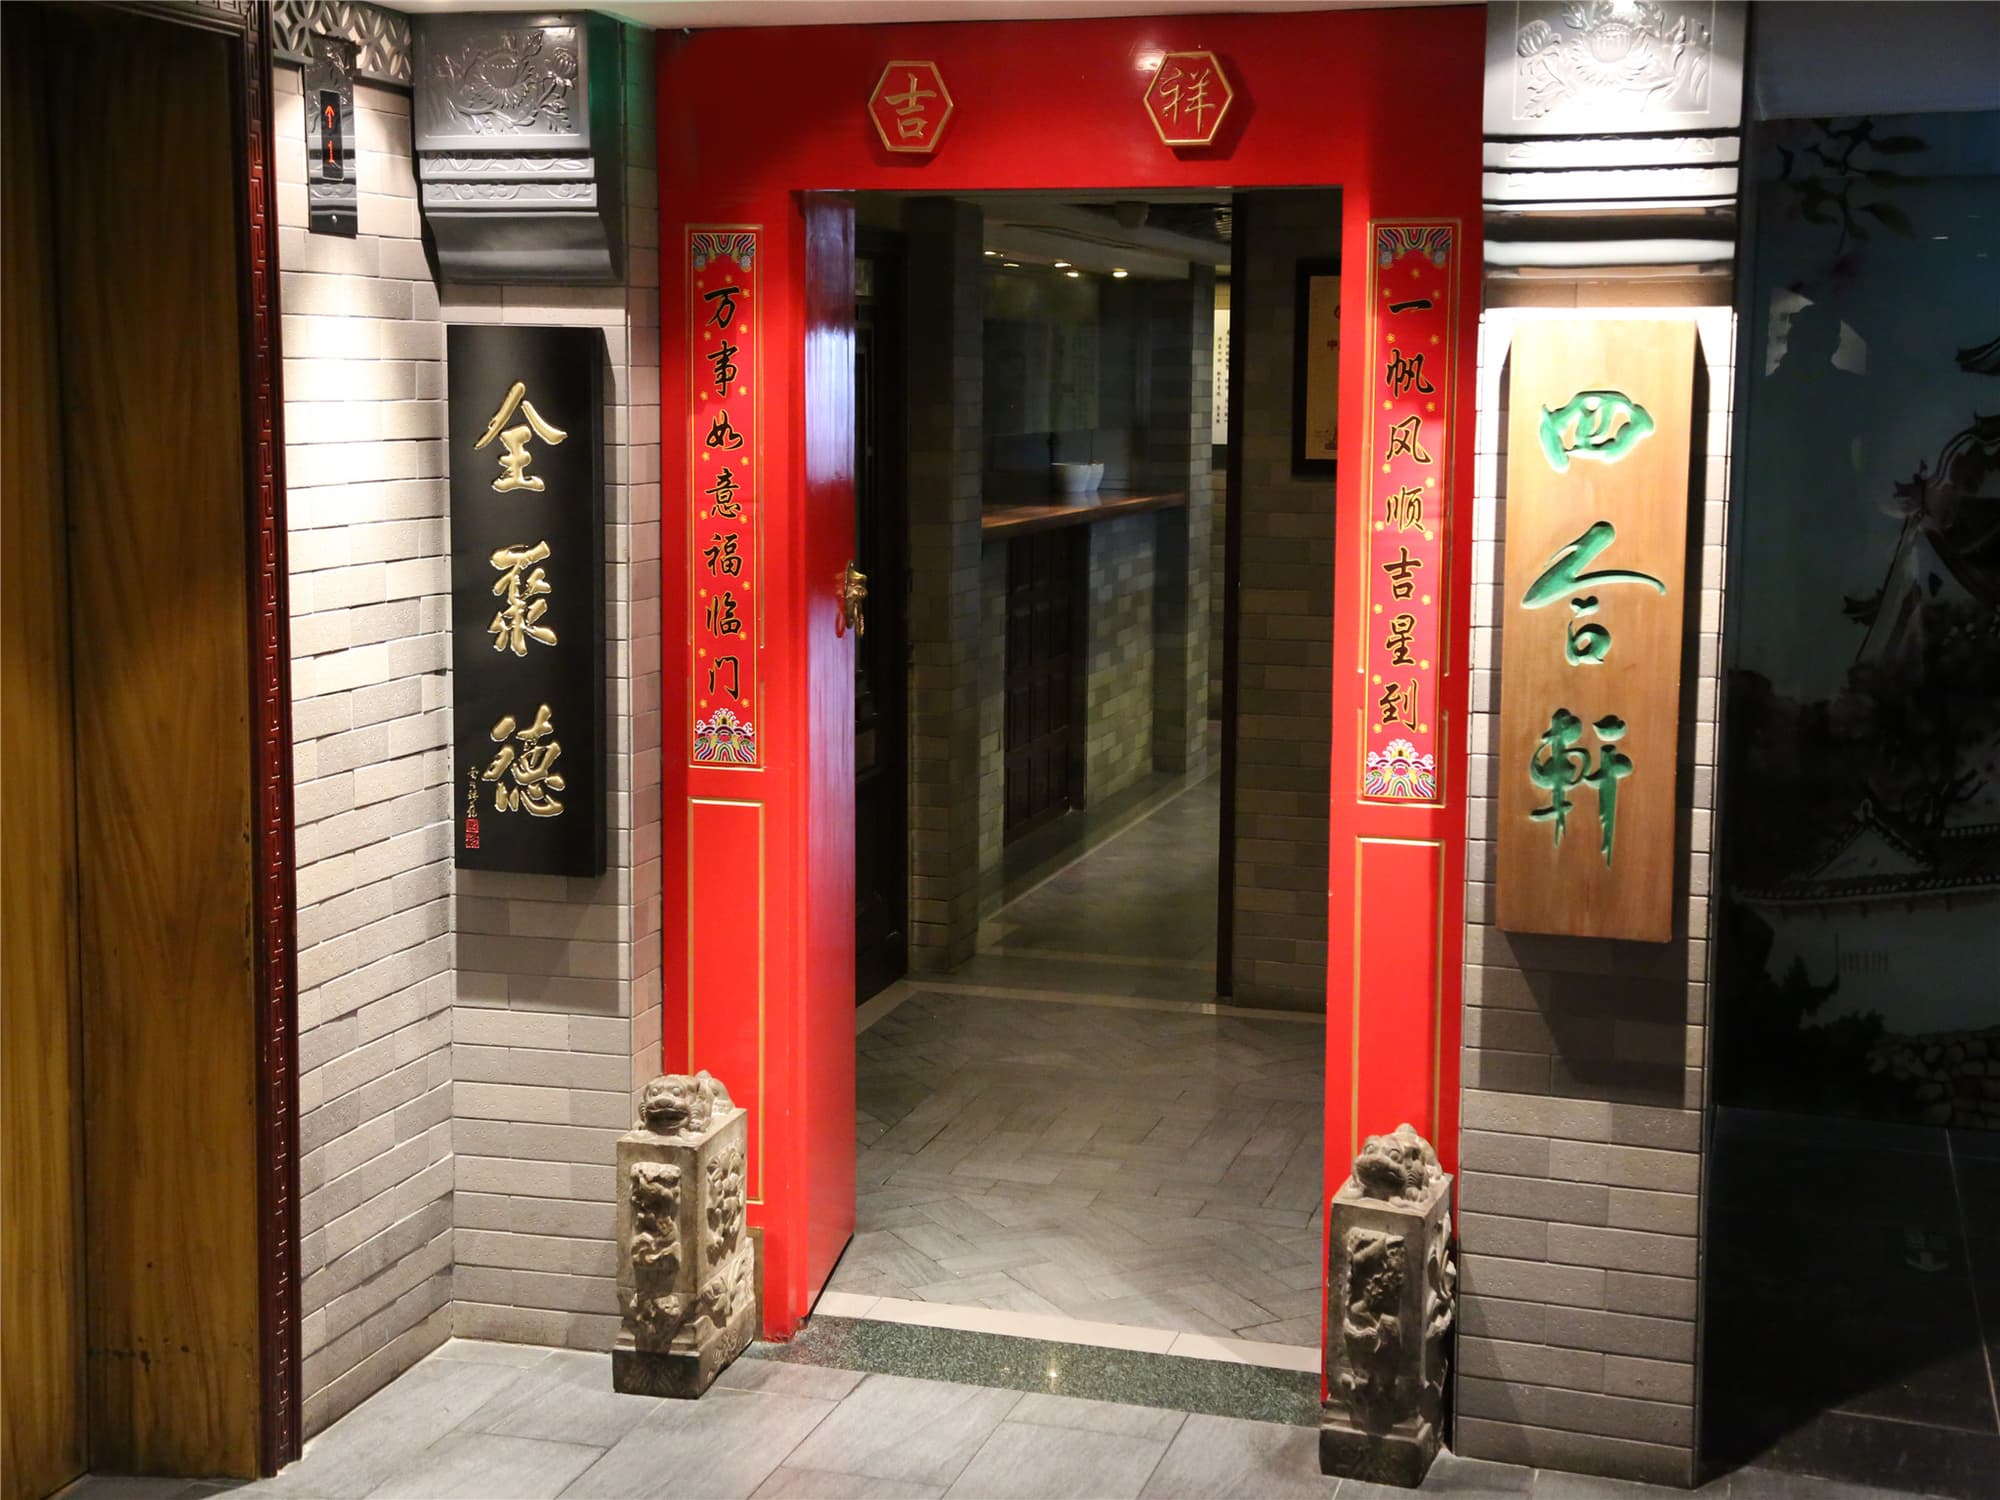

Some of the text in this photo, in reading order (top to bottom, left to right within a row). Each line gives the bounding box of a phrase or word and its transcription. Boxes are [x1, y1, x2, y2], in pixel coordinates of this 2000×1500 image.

[885, 68, 1216, 138] 吉 祥
[473, 381, 568, 819] 全聚德
[703, 288, 743, 700] 万事如意福临门
[1379, 299, 1434, 730] 一帆风顺吉星到
